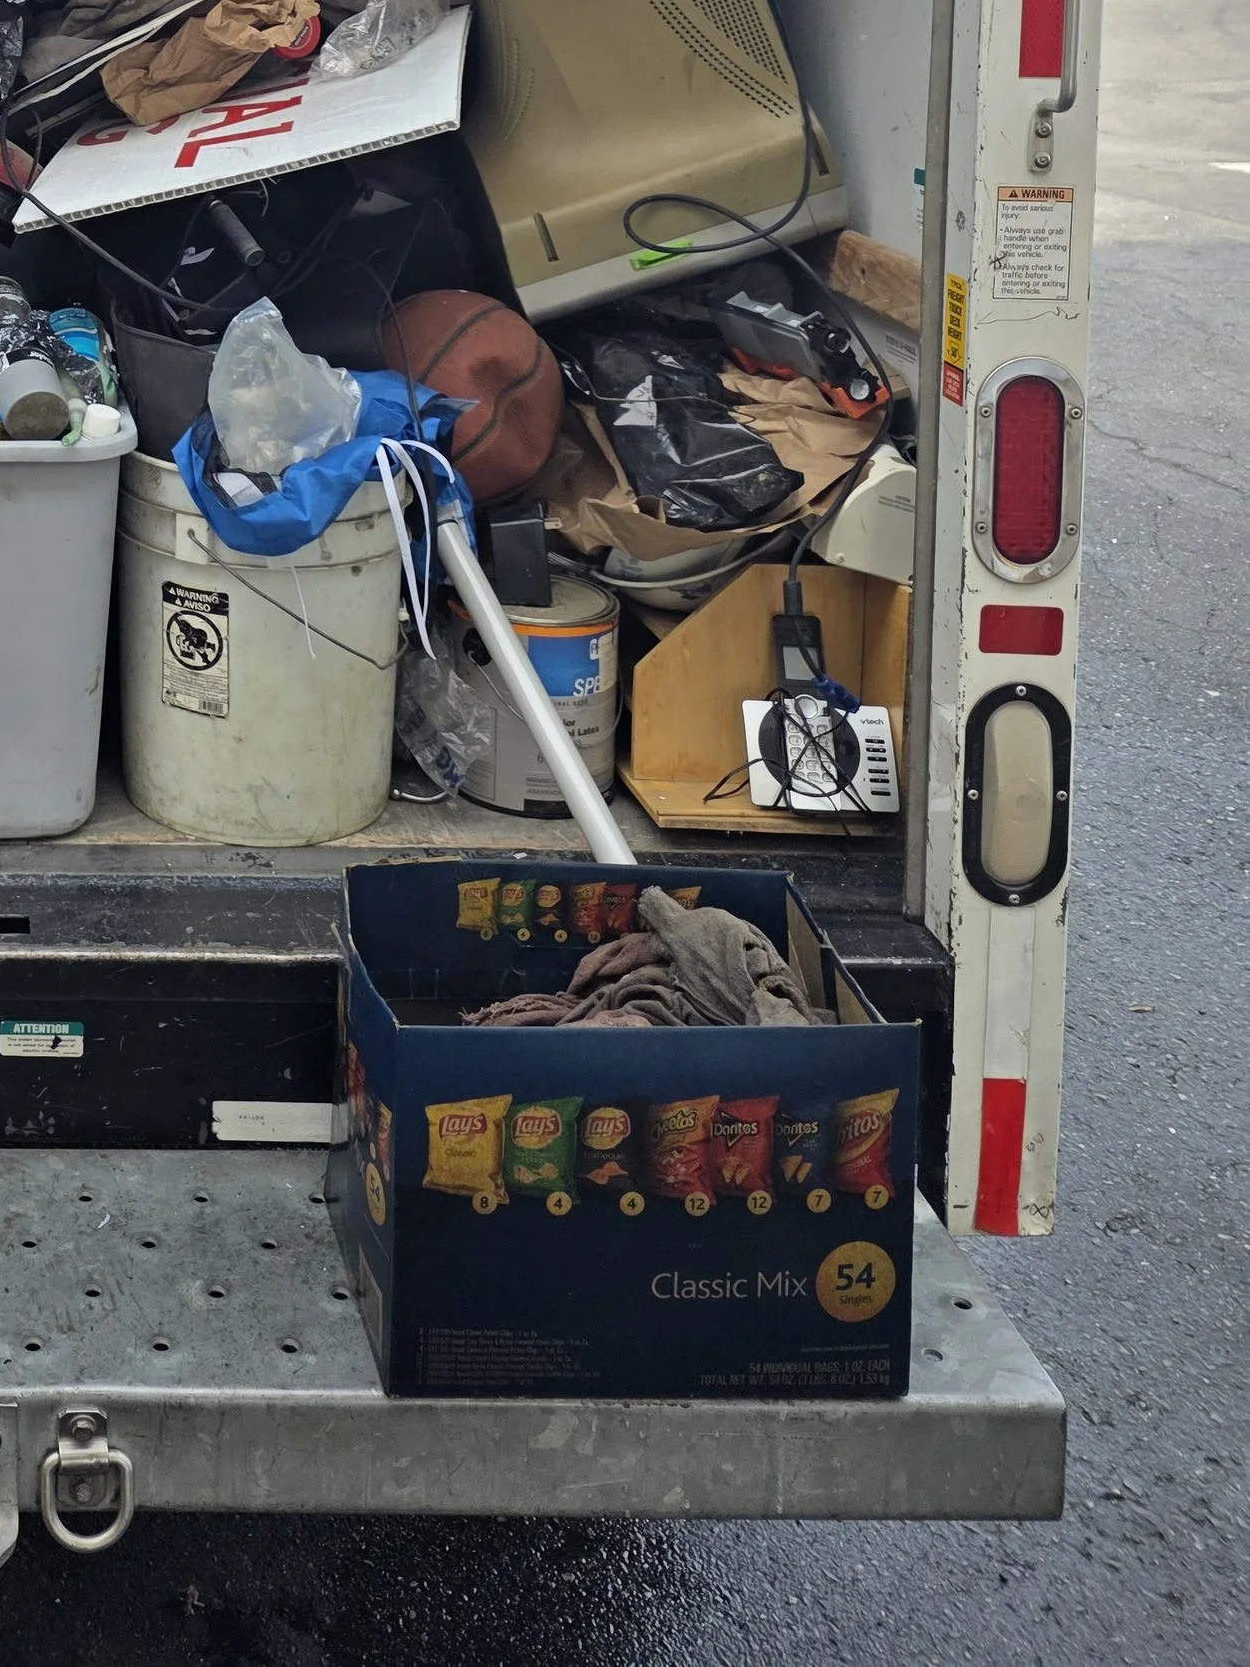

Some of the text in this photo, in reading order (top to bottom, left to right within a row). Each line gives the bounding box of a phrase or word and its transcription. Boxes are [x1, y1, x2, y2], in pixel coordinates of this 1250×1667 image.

[1021, 189, 1066, 200] WARNING
[1001, 204, 1054, 212] To avoid serious
[1004, 226, 1031, 236] Always
[1048, 227, 1064, 237] grab
[1003, 235, 1049, 243] handle when
[1003, 243, 1067, 253] entering exiting
[1017, 250, 1044, 259] vehicle.
[1002, 263, 1065, 273] Always check for
[1002, 271, 1048, 280] traffic before
[1002, 279, 1066, 290] entering exiting
[947, 288, 965, 304] FREIGHT
[1001, 287, 1015, 295] this
[949, 302, 963, 317] TRUCK
[950, 314, 962, 329] DECK
[947, 326, 963, 342] HEIGHT
[176, 587, 220, 605] WARNING
[183, 599, 212, 613] AVISO
[860, 717, 885, 726] vtech
[577, 726, 600, 737] Latex
[13, 1023, 70, 1035] ATTENTION
[713, 1120, 759, 1137] Doritos
[479, 1190, 882, 1212] 8 4 4 12 12 7 7
[835, 1262, 877, 1291] 54
[652, 1271, 808, 1300] Classic Mix
[838, 1293, 873, 1307] Singles
